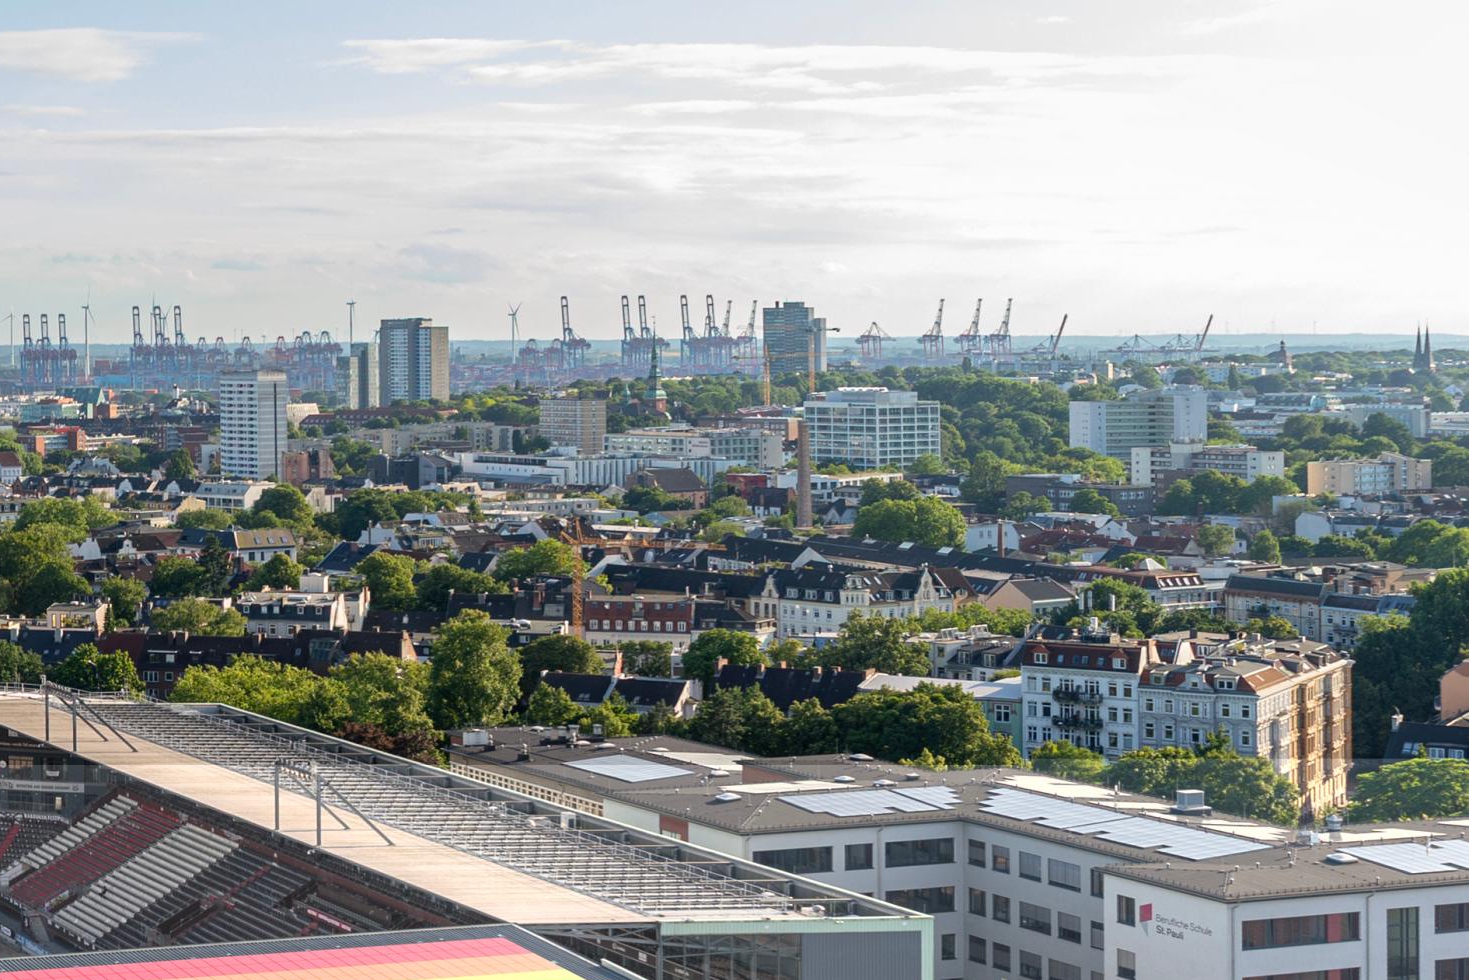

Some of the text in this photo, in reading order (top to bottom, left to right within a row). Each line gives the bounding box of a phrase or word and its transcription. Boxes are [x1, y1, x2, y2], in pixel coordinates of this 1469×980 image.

[1155, 913, 1213, 937] Berufliche Schule
[1156, 925, 1184, 940] St. Pauli
